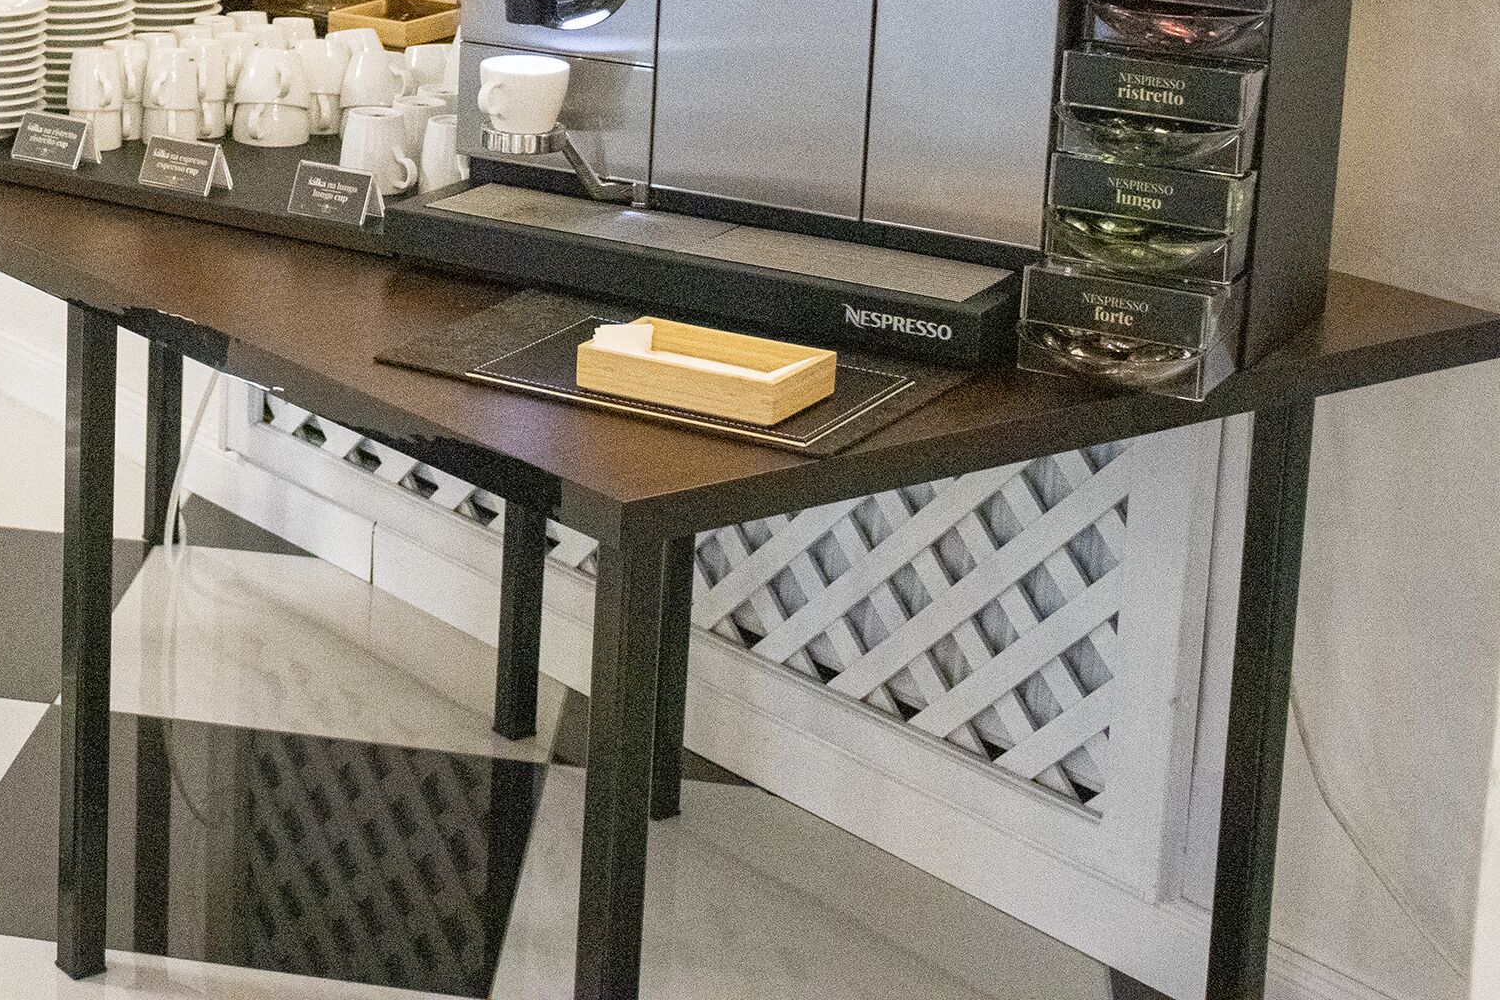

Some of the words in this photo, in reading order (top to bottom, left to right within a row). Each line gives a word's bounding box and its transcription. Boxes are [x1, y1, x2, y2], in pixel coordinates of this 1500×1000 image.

[1119, 72, 1186, 90] NESPRESSO
[1117, 83, 1184, 106] ristretto
[56, 140, 69, 149] cup
[186, 167, 199, 177] cup
[1107, 176, 1174, 196] NESPRESSO
[334, 194, 349, 204] cup
[1116, 188, 1162, 211] lungo
[1082, 292, 1149, 312] NESPRESSO
[841, 303, 953, 341] NESPRESSO
[1094, 305, 1134, 326] forte
